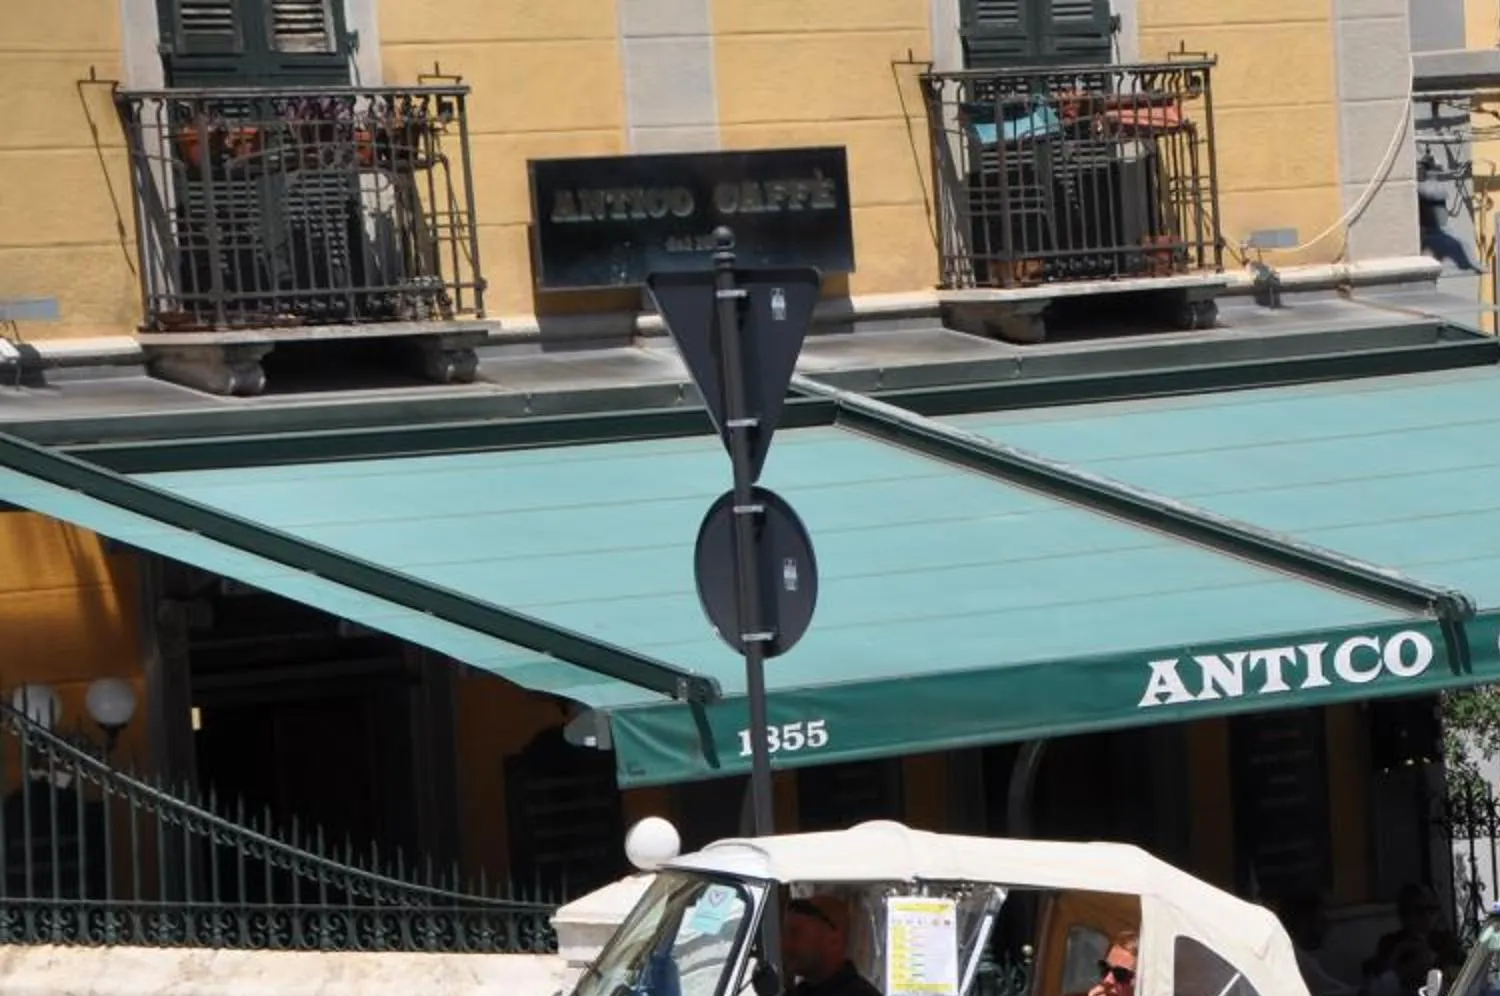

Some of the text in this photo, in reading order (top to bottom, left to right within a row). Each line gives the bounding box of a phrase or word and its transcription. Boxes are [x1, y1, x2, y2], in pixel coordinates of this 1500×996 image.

[551, 187, 694, 222] ANTICO
[1138, 630, 1433, 707] ANTICO
[737, 719, 829, 757] 1855
